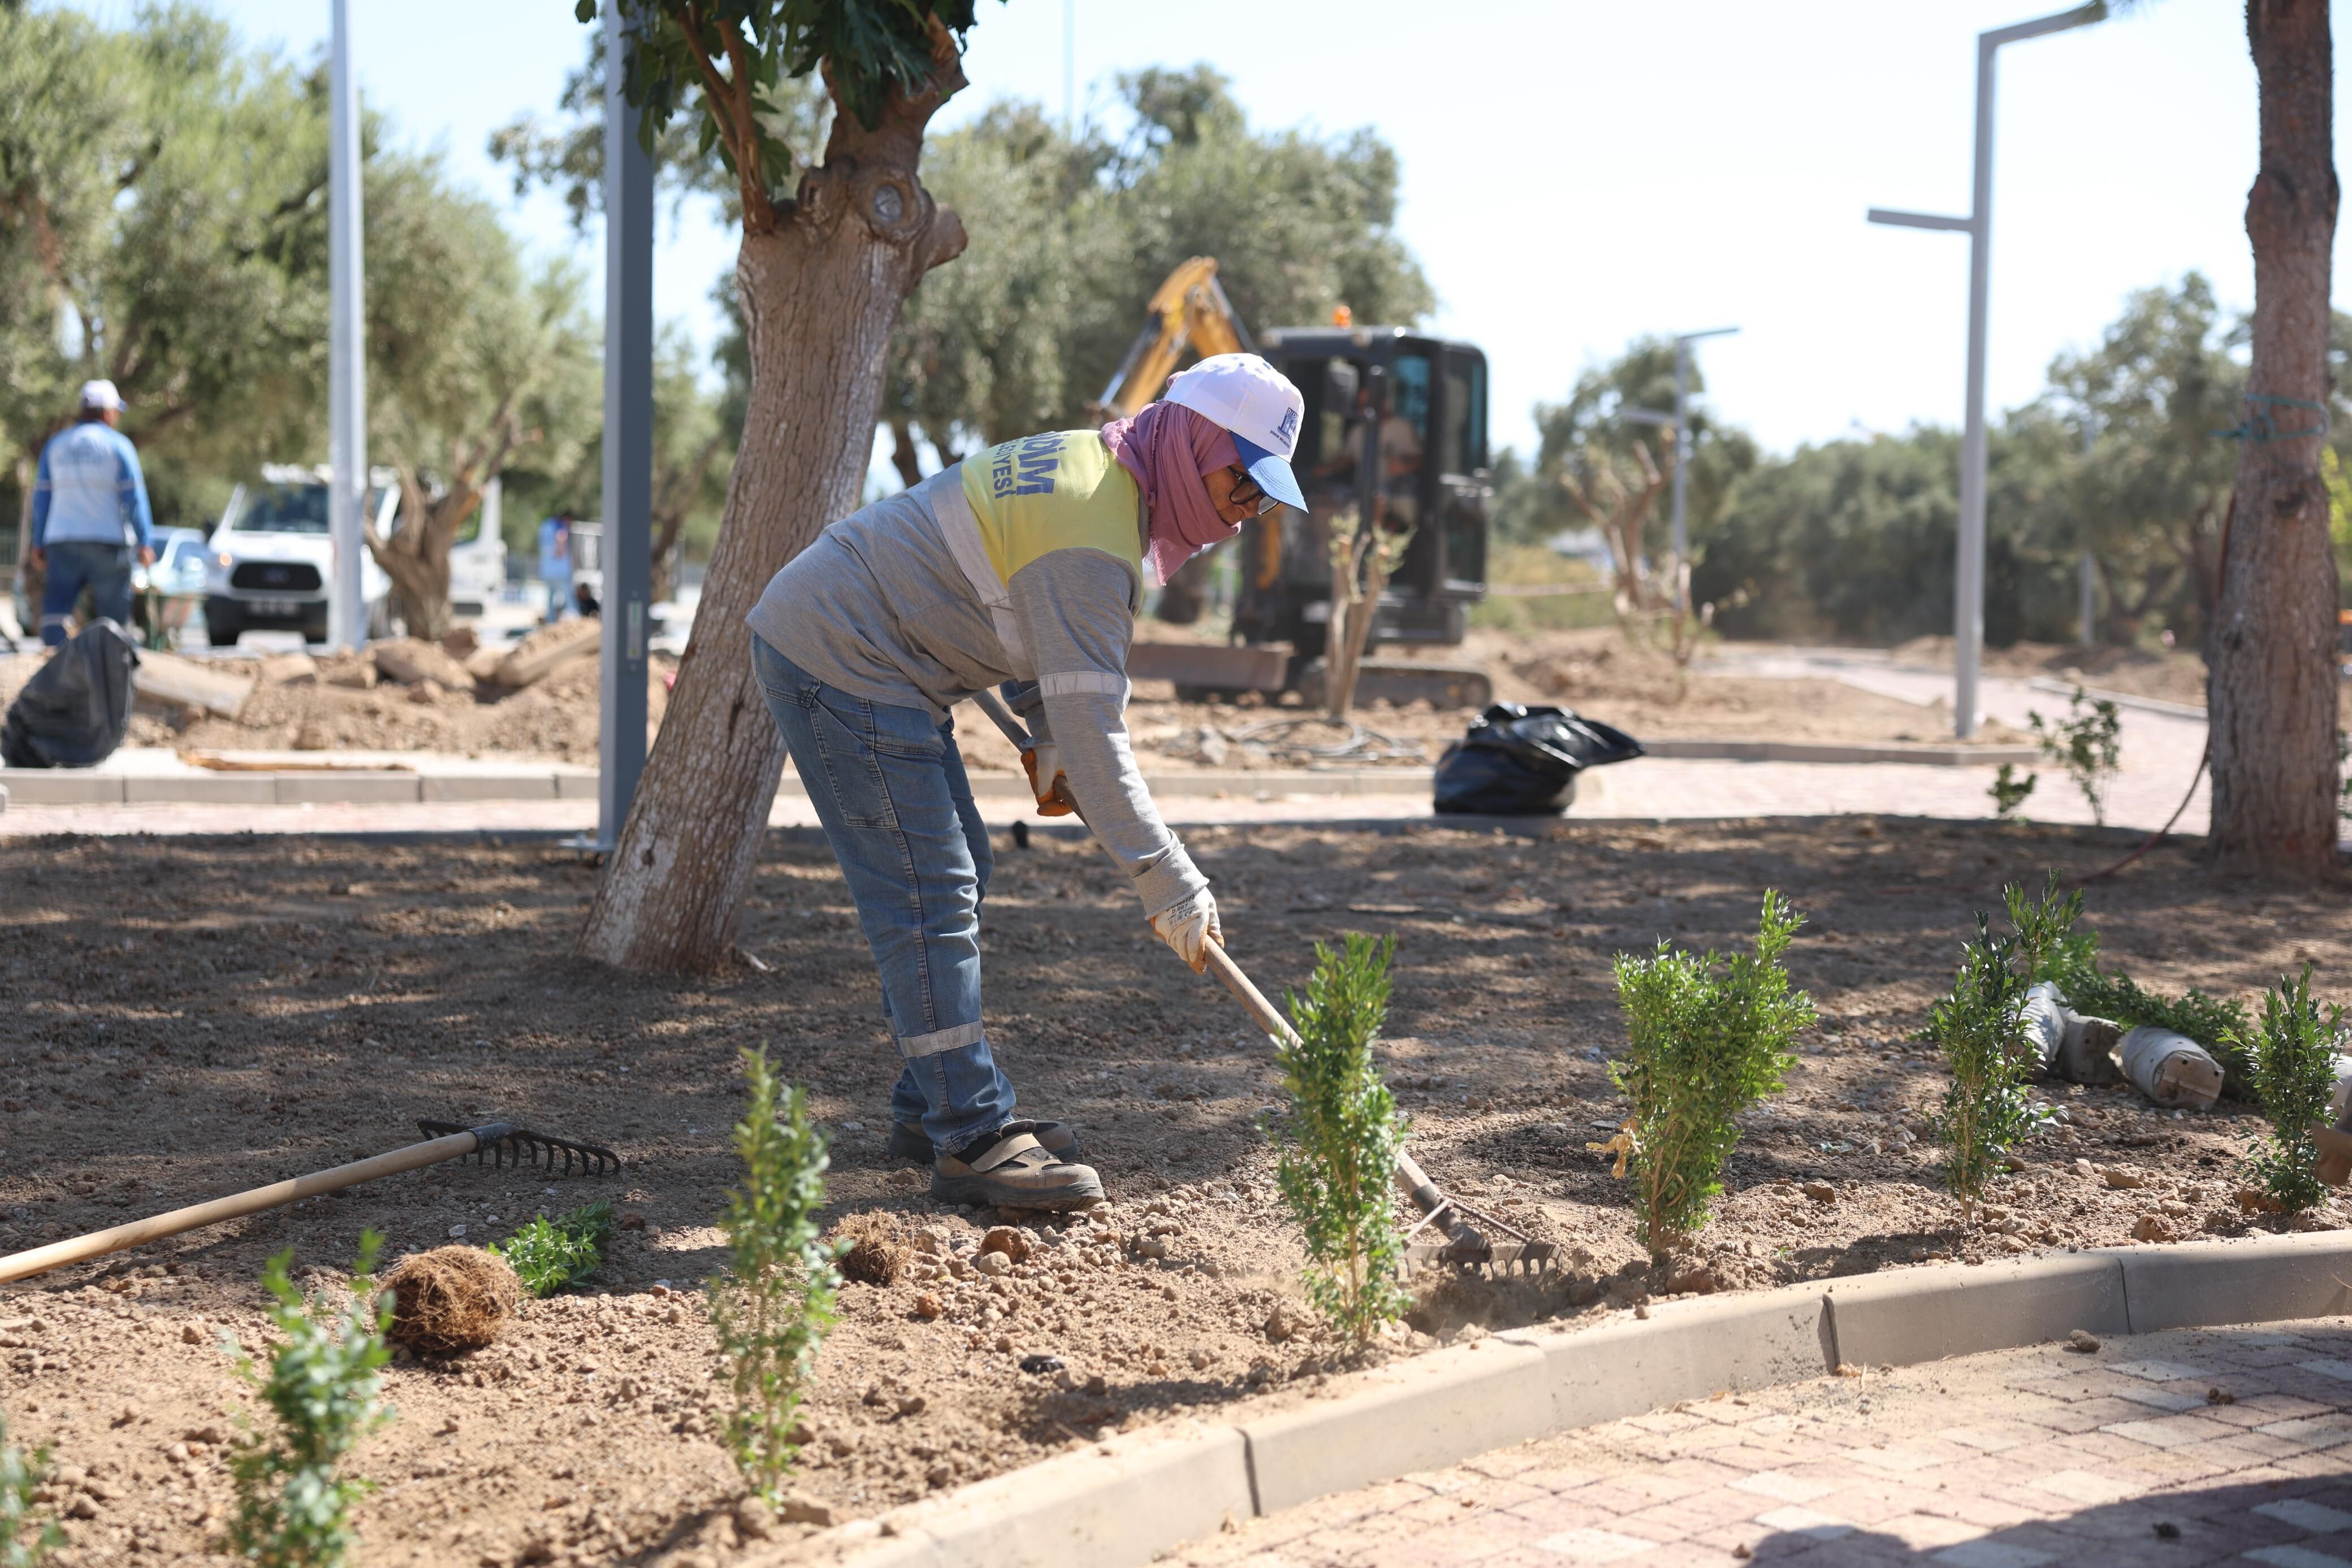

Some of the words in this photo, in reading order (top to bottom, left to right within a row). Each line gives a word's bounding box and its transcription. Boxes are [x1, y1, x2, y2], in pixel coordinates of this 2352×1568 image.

[993, 439, 1020, 499] LEDİYESİ
[1016, 431, 1071, 496] İDİM
[1172, 903, 1188, 914] D.007
